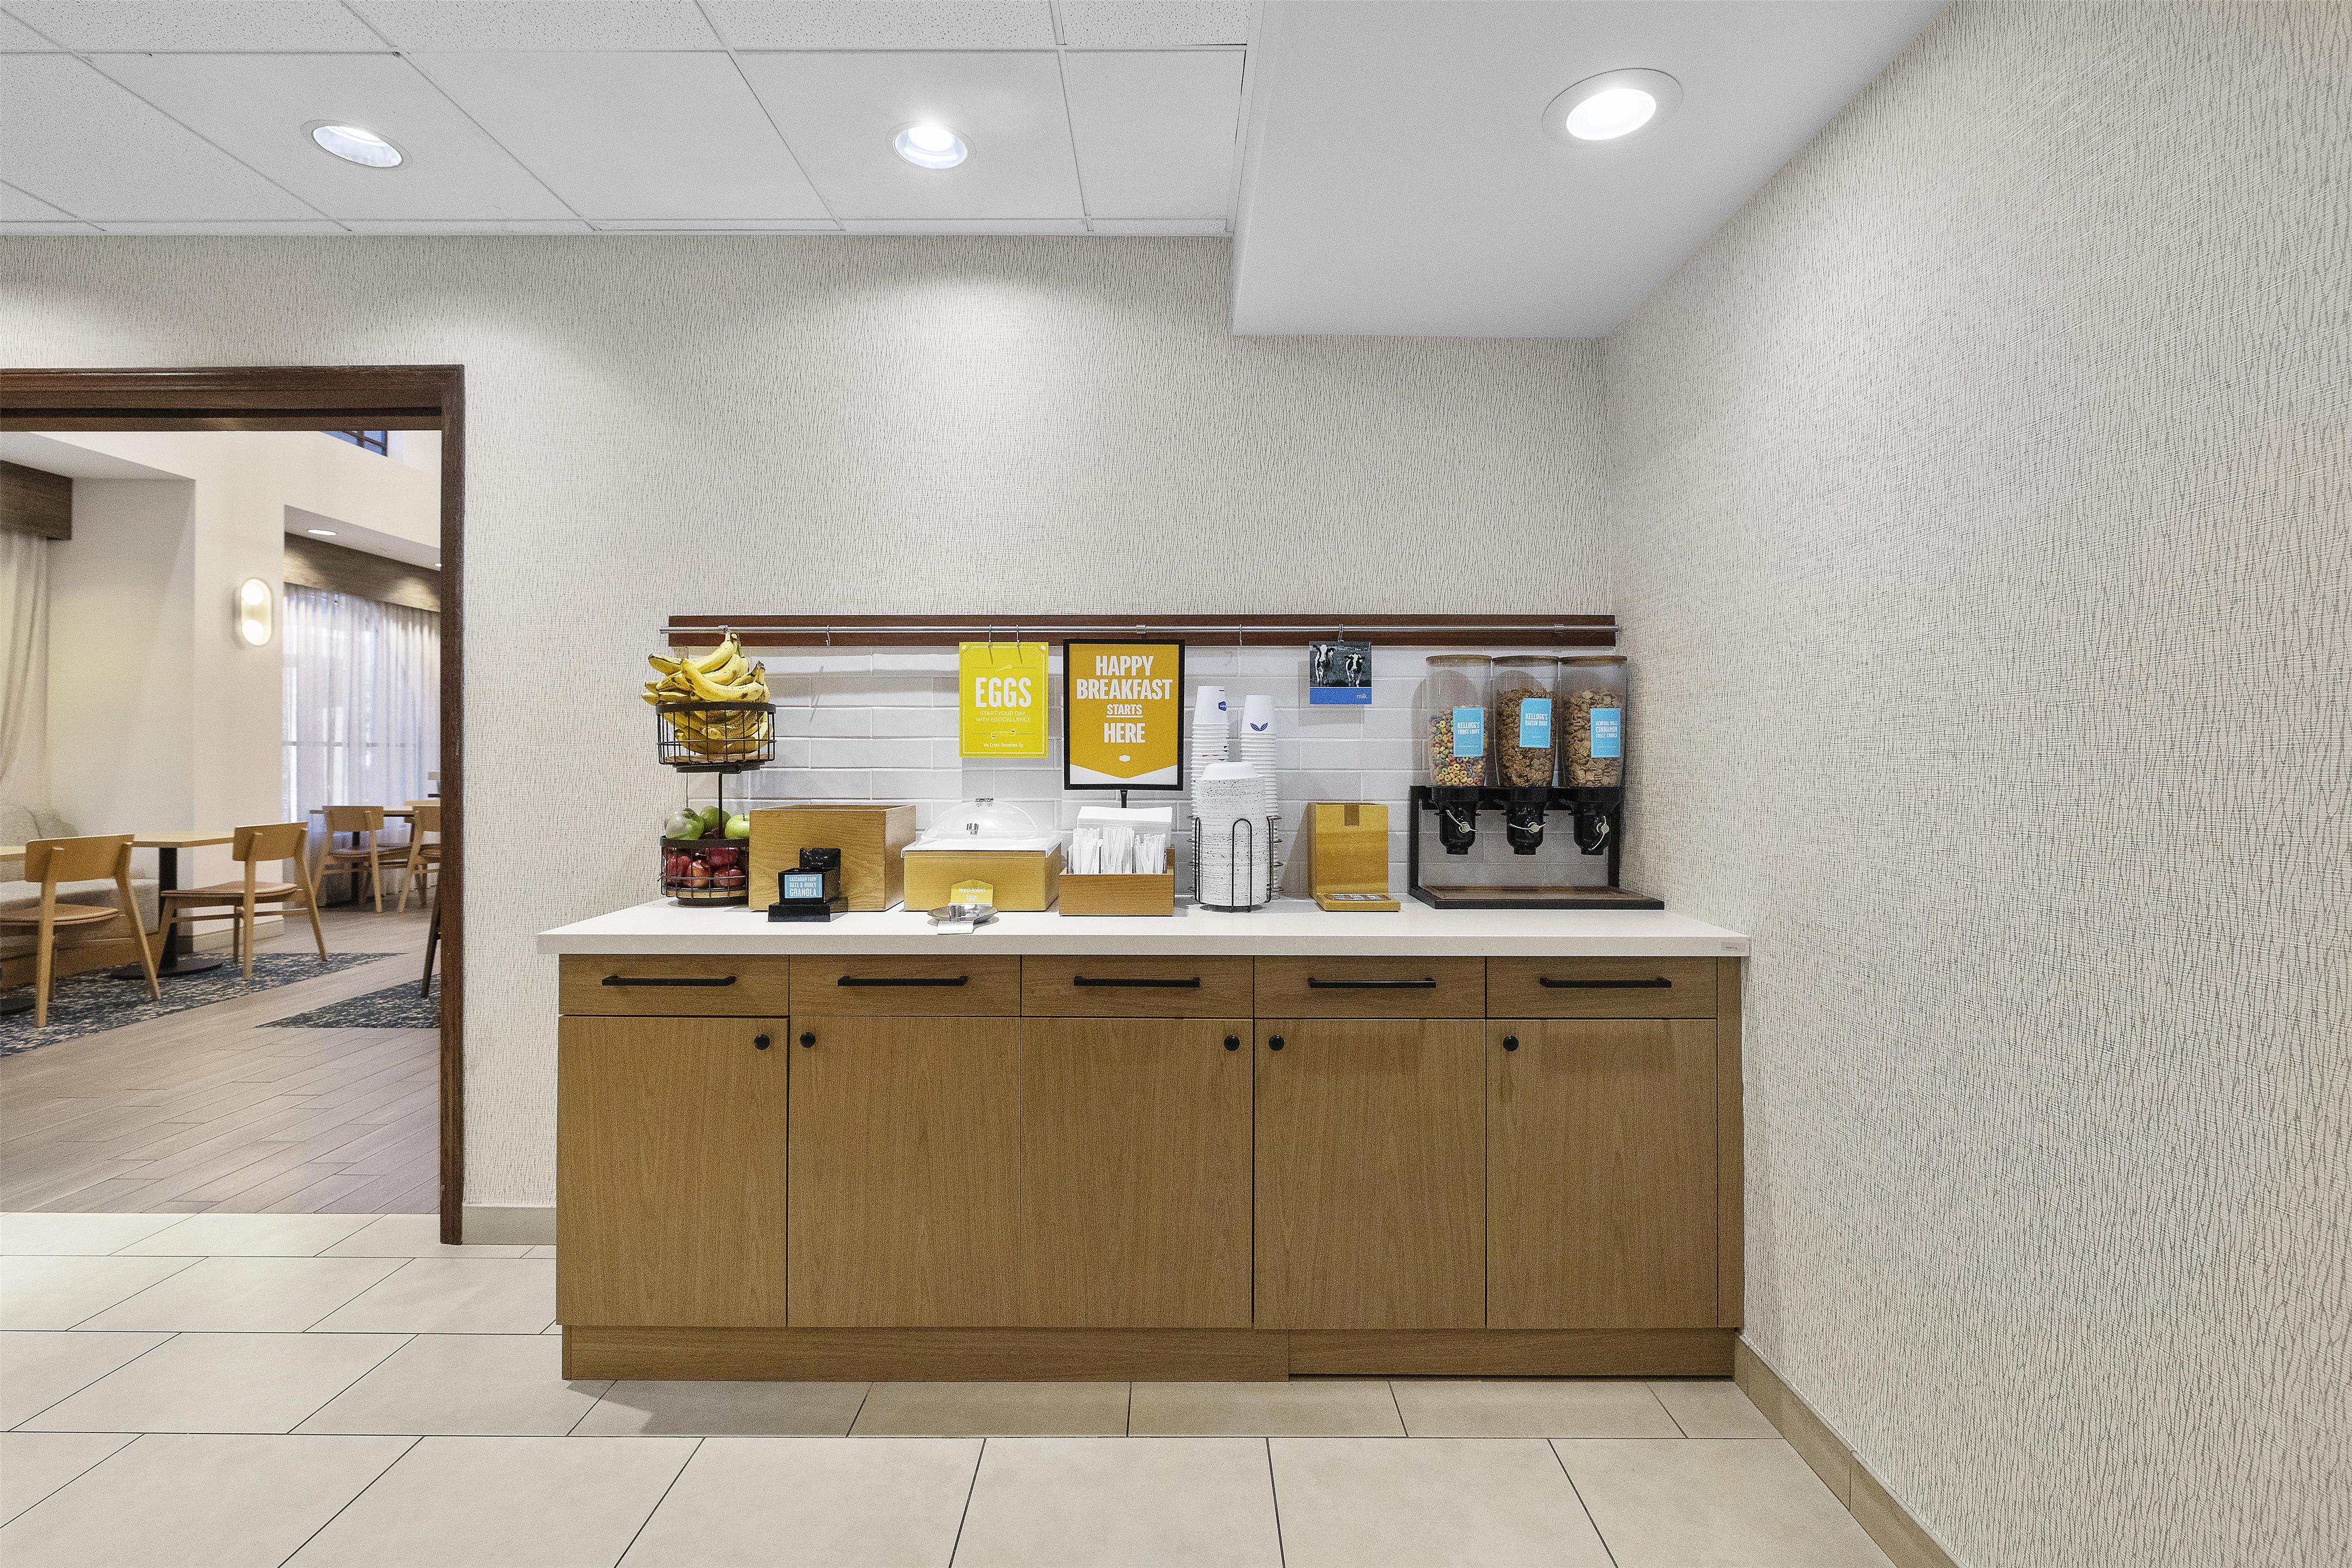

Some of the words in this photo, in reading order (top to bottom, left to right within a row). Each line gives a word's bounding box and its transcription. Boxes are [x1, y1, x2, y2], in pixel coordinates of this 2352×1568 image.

[1095, 655, 1154, 676] HAPPY
[975, 677, 1032, 708] EGGS
[1076, 678, 1173, 700] BREAKFAST
[1106, 703, 1142, 715] STARTS
[1104, 722, 1146, 743] HERE
[789, 888, 817, 897] GRANOLA
